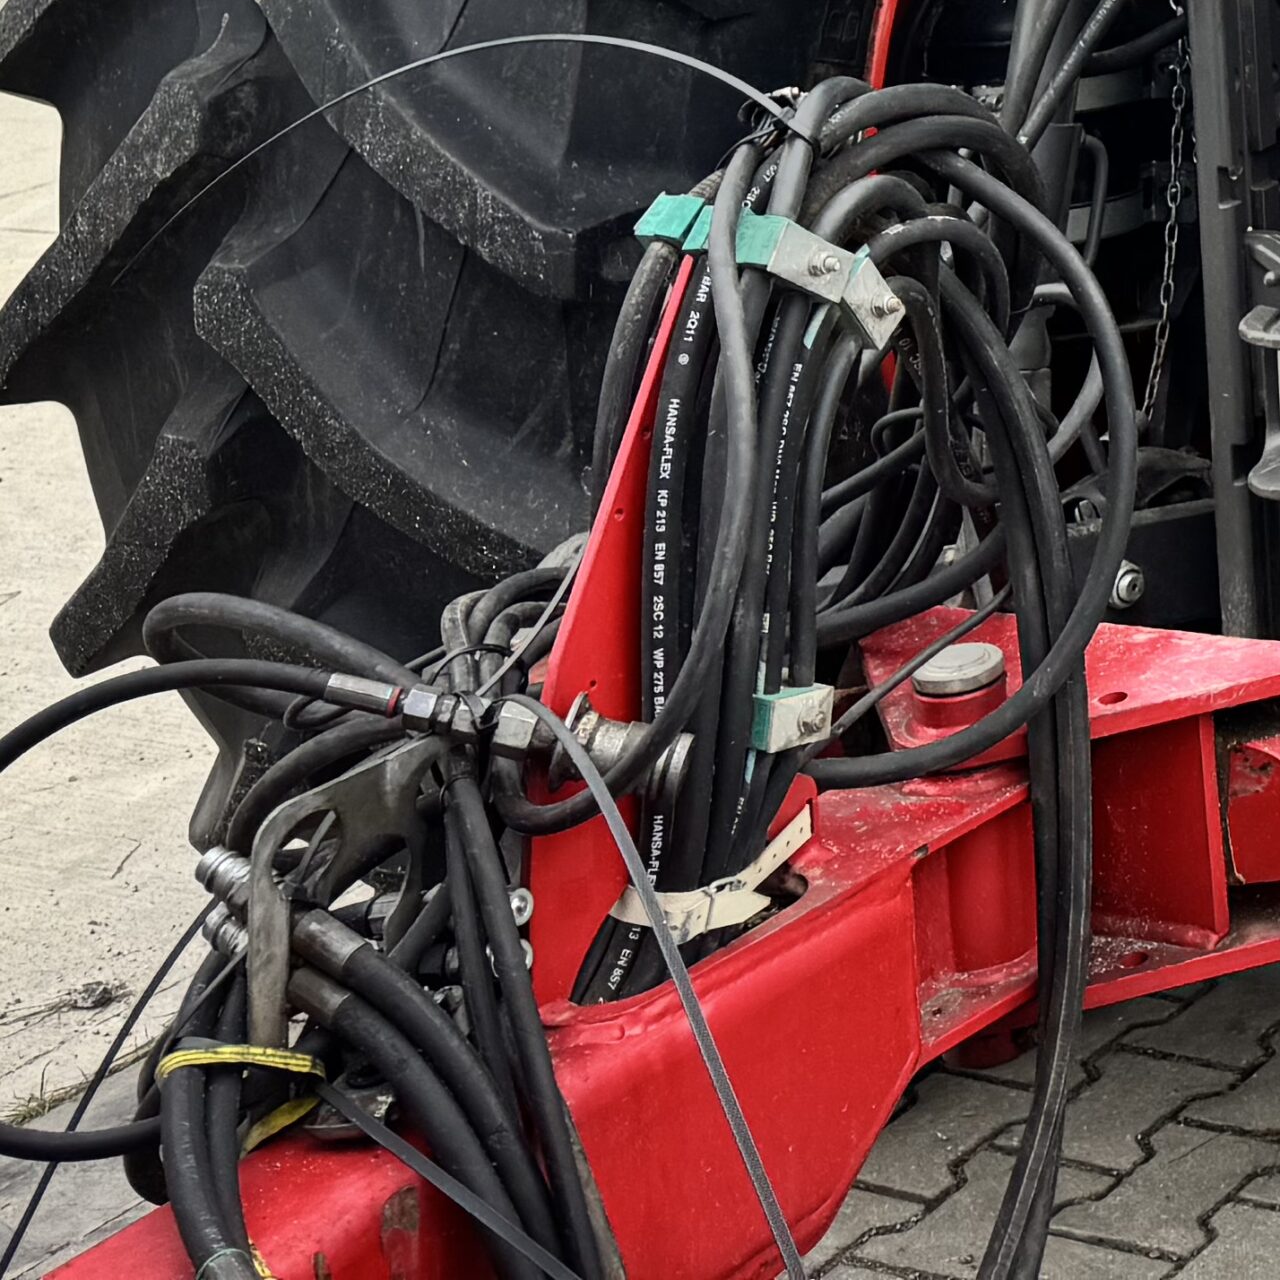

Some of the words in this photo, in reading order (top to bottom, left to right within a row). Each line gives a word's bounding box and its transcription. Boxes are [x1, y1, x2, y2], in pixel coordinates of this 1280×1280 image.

[659, 398, 681, 480] HANSA-FLEX
[657, 489, 669, 508] KP
[655, 510, 666, 533] 213
[654, 542, 666, 561] EN
[653, 563, 665, 586] 857
[652, 595, 664, 621] 2SC
[652, 625, 664, 639] 12
[652, 647, 664, 669] WP
[653, 671, 664, 694] 275
[647, 814, 664, 888] HANSA-FLE
[628, 926, 641, 941] 13
[616, 948, 633, 968] EN
[607, 967, 624, 991] 857
